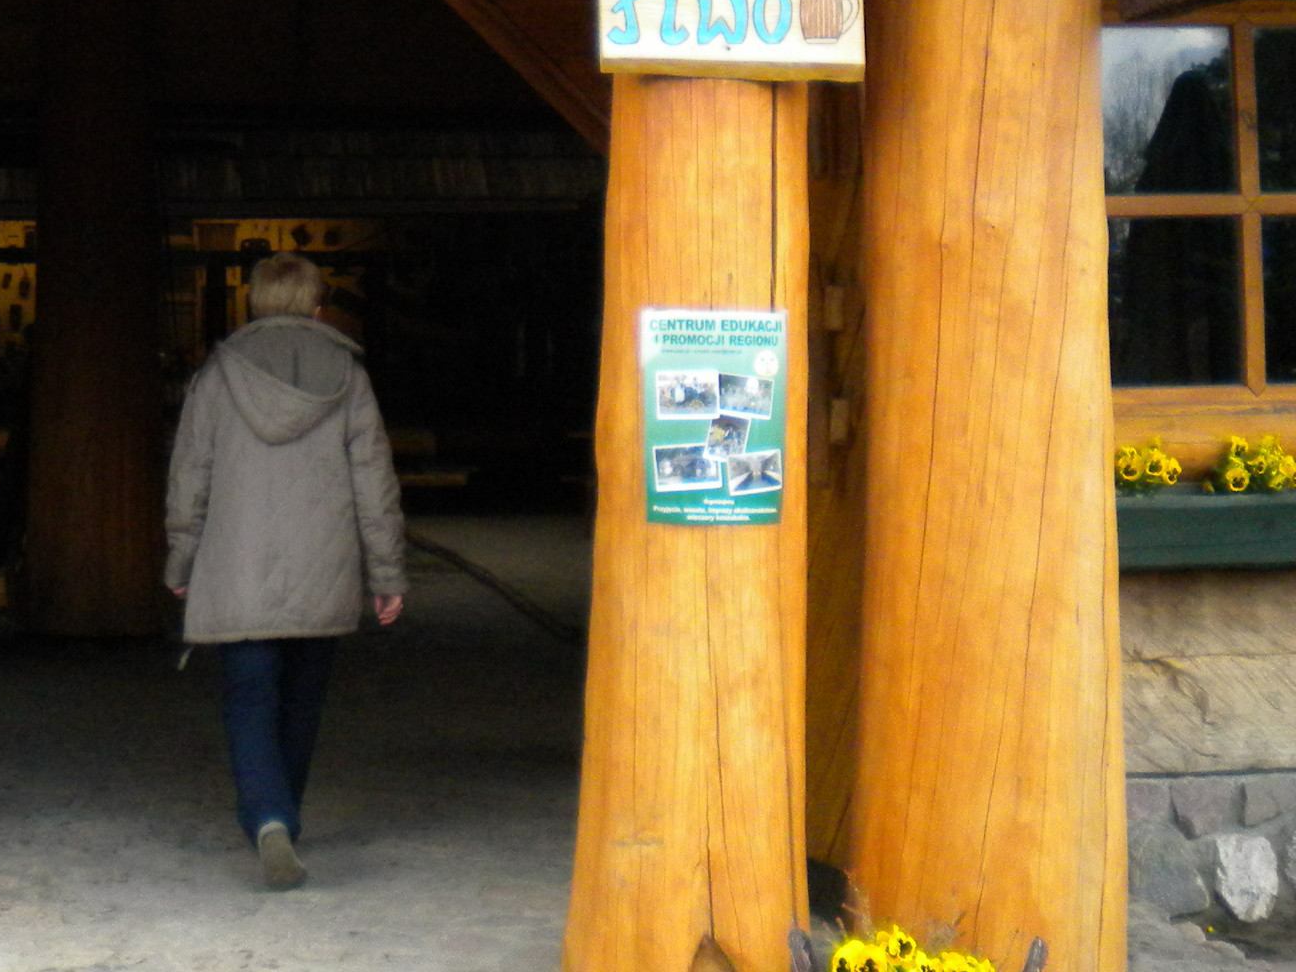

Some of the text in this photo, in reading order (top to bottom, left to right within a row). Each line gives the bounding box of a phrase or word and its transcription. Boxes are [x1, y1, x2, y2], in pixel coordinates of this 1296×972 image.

[649, 318, 783, 333] CENTRUM EDUKACJI
[662, 334, 725, 346] PROMOCJI
[729, 335, 779, 347] REGIONU
